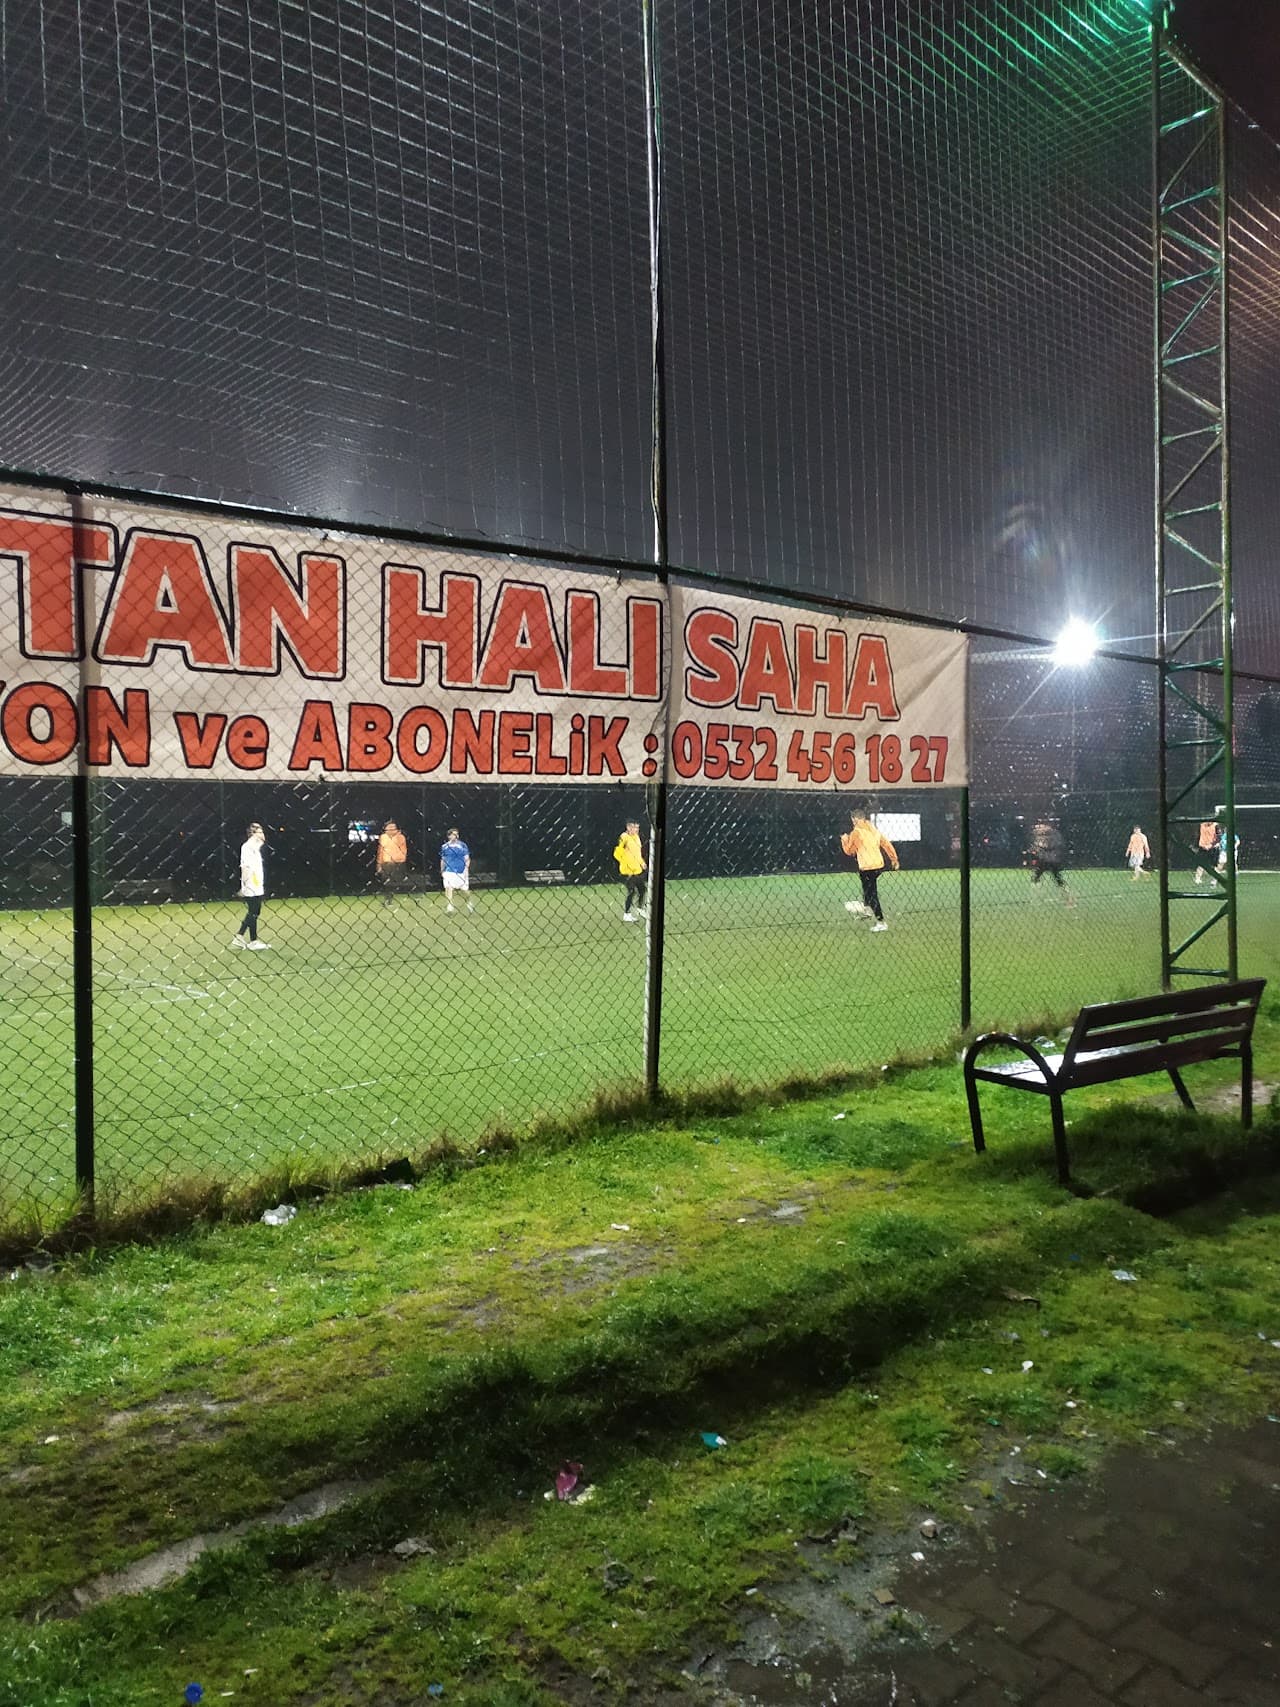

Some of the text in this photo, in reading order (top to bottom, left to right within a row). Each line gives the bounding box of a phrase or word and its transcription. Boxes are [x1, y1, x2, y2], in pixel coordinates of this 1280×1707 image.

[381, 562, 663, 702] HALI
[684, 606, 900, 721] SAHA
[0, 680, 151, 767] ON
[173, 712, 269, 769] ve
[672, 721, 778, 781] 0532
[787, 730, 856, 783] 456
[865, 734, 903, 783] 18
[910, 735, 949, 782] 27
